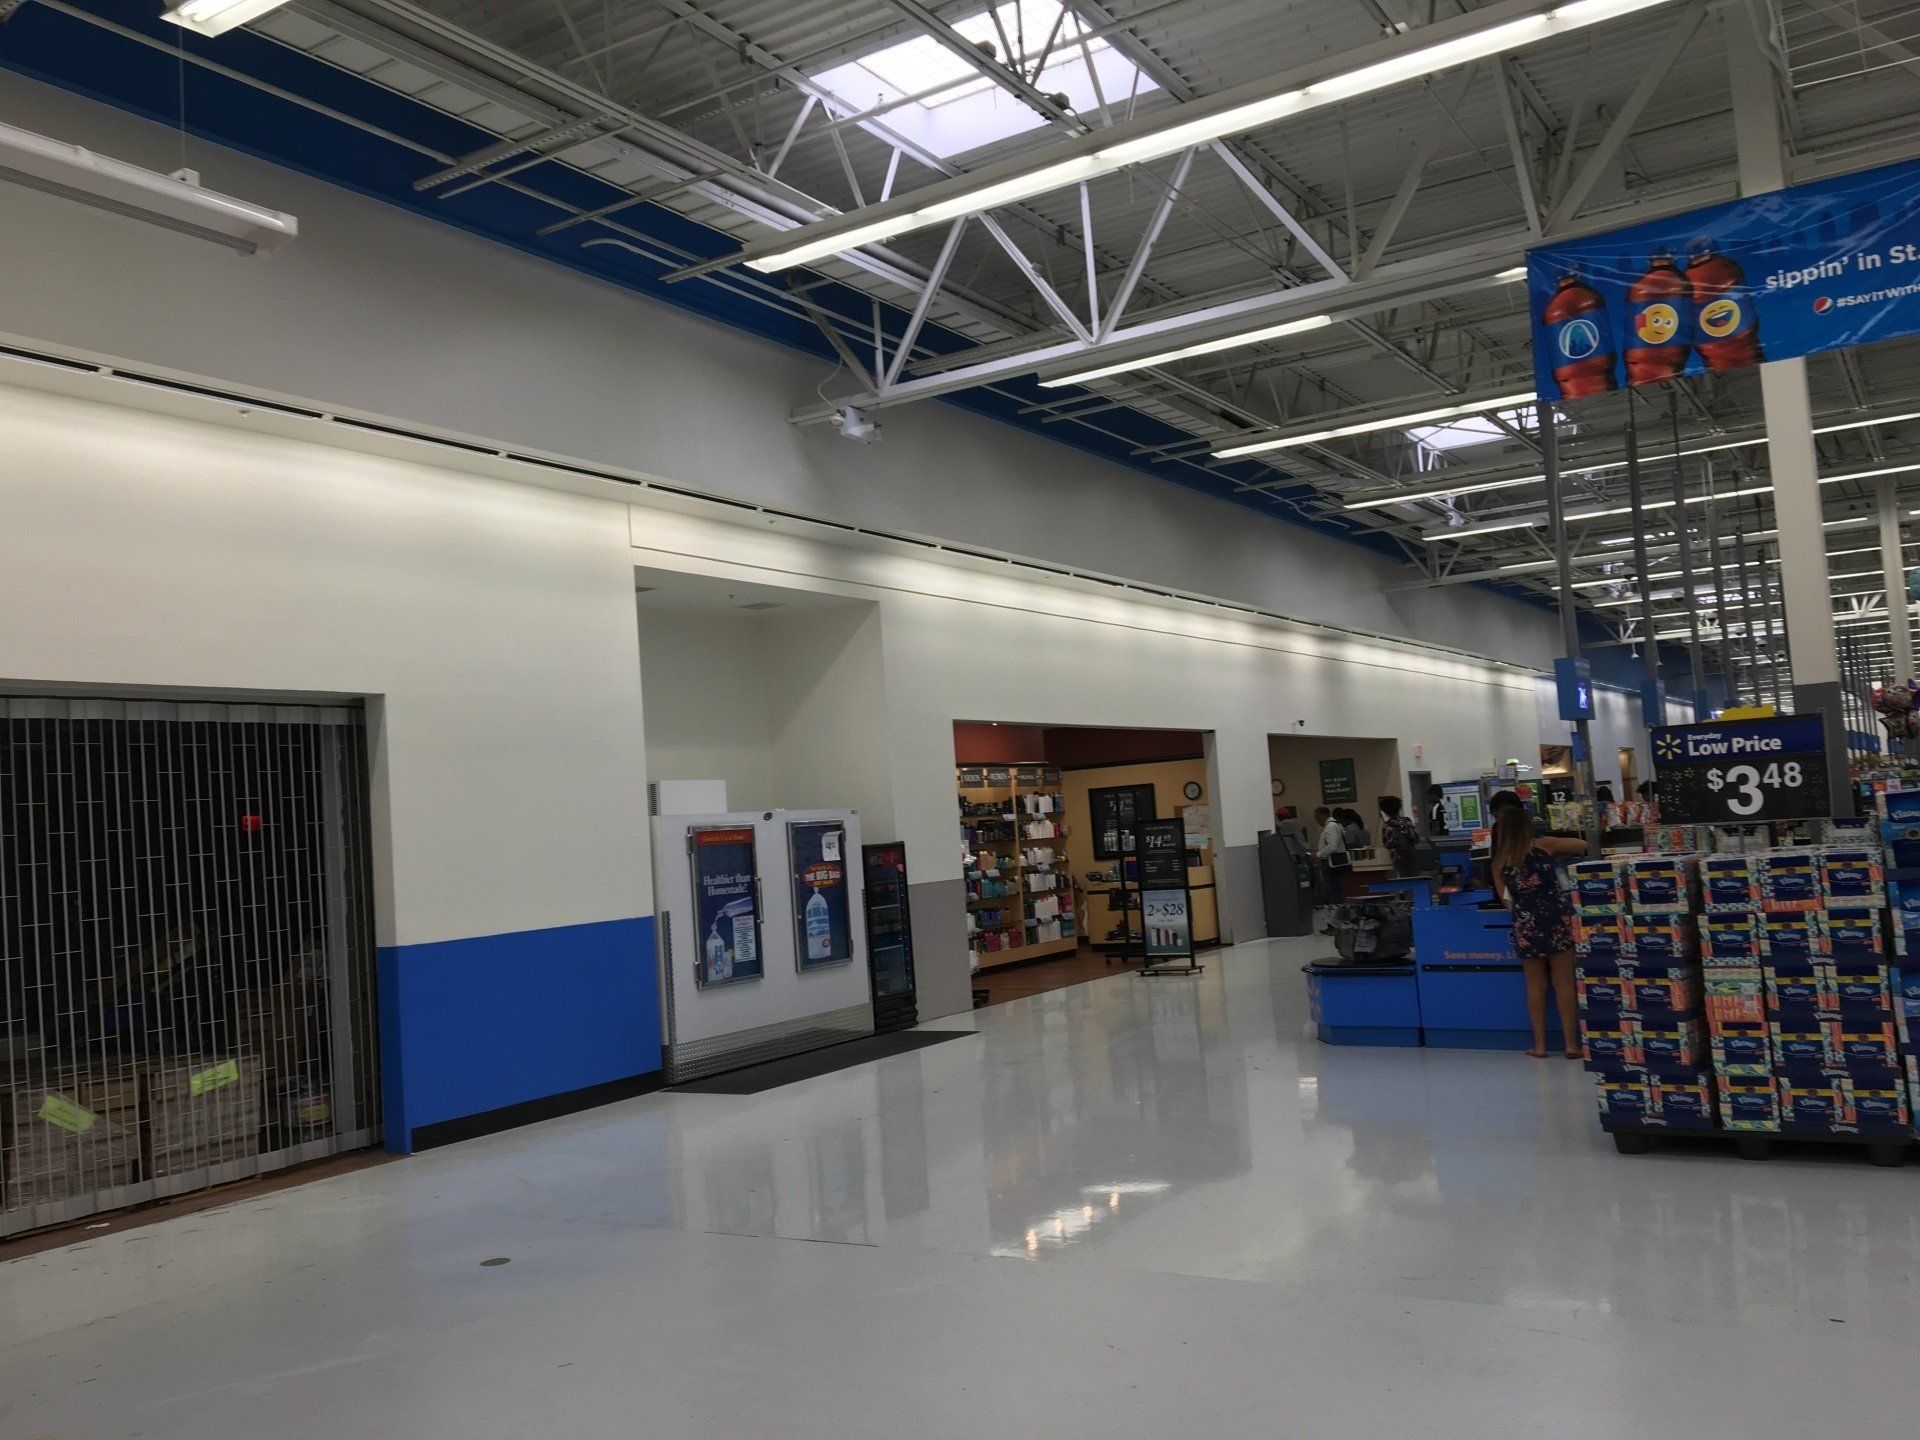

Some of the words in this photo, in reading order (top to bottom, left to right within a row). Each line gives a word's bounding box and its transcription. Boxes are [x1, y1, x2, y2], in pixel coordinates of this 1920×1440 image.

[1857, 252, 1882, 271] in
[1686, 732, 1722, 741] Everyday
[1687, 740, 1729, 756] Low
[1731, 735, 1783, 753] Price
[1552, 791, 1566, 802] 12
[703, 874, 734, 886] Healthier
[1147, 904, 1155, 916] 2
[1161, 903, 1184, 916] $28
